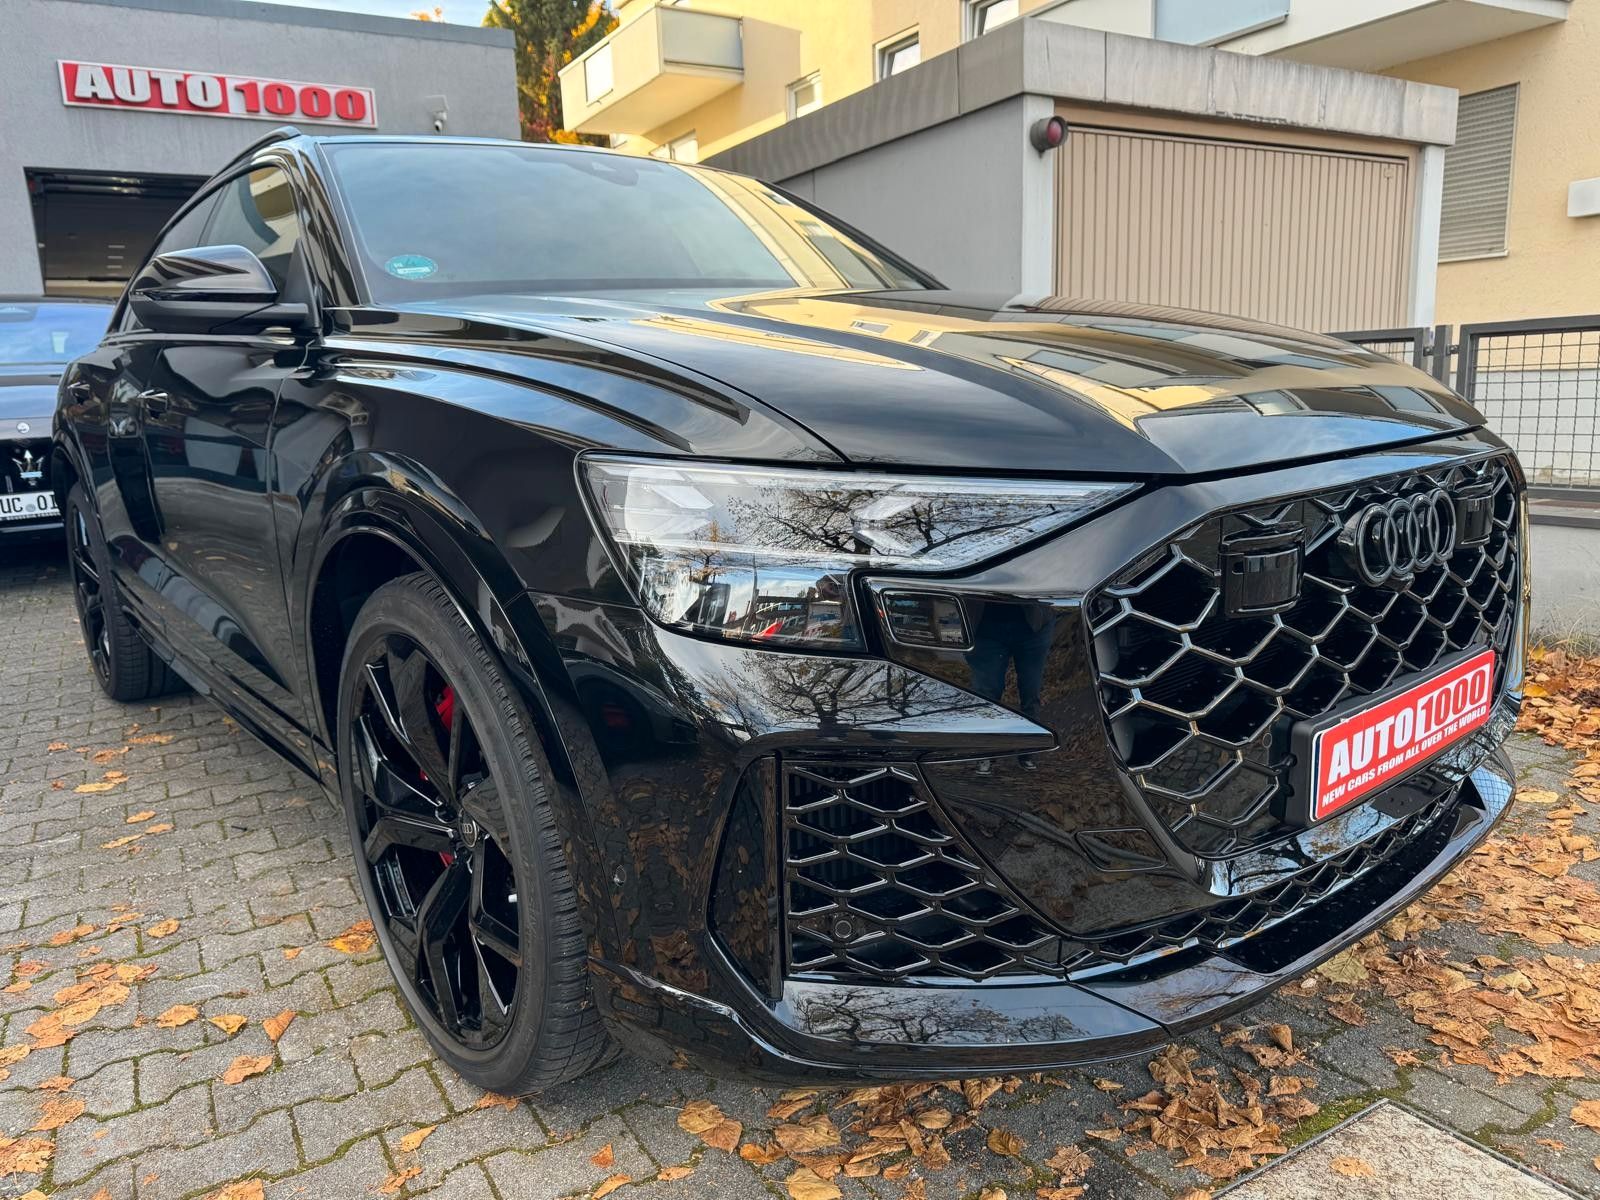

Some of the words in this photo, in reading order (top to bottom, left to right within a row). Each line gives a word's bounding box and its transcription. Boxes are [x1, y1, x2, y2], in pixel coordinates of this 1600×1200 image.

[1322, 783, 1346, 808] NEW
[1347, 768, 1376, 791] CARS
[1377, 754, 1404, 775] FROM
[1405, 744, 1420, 760] ALL
[1421, 731, 1443, 751] OVER
[1444, 721, 1458, 737] THE
[1459, 705, 1486, 729] WORLD
